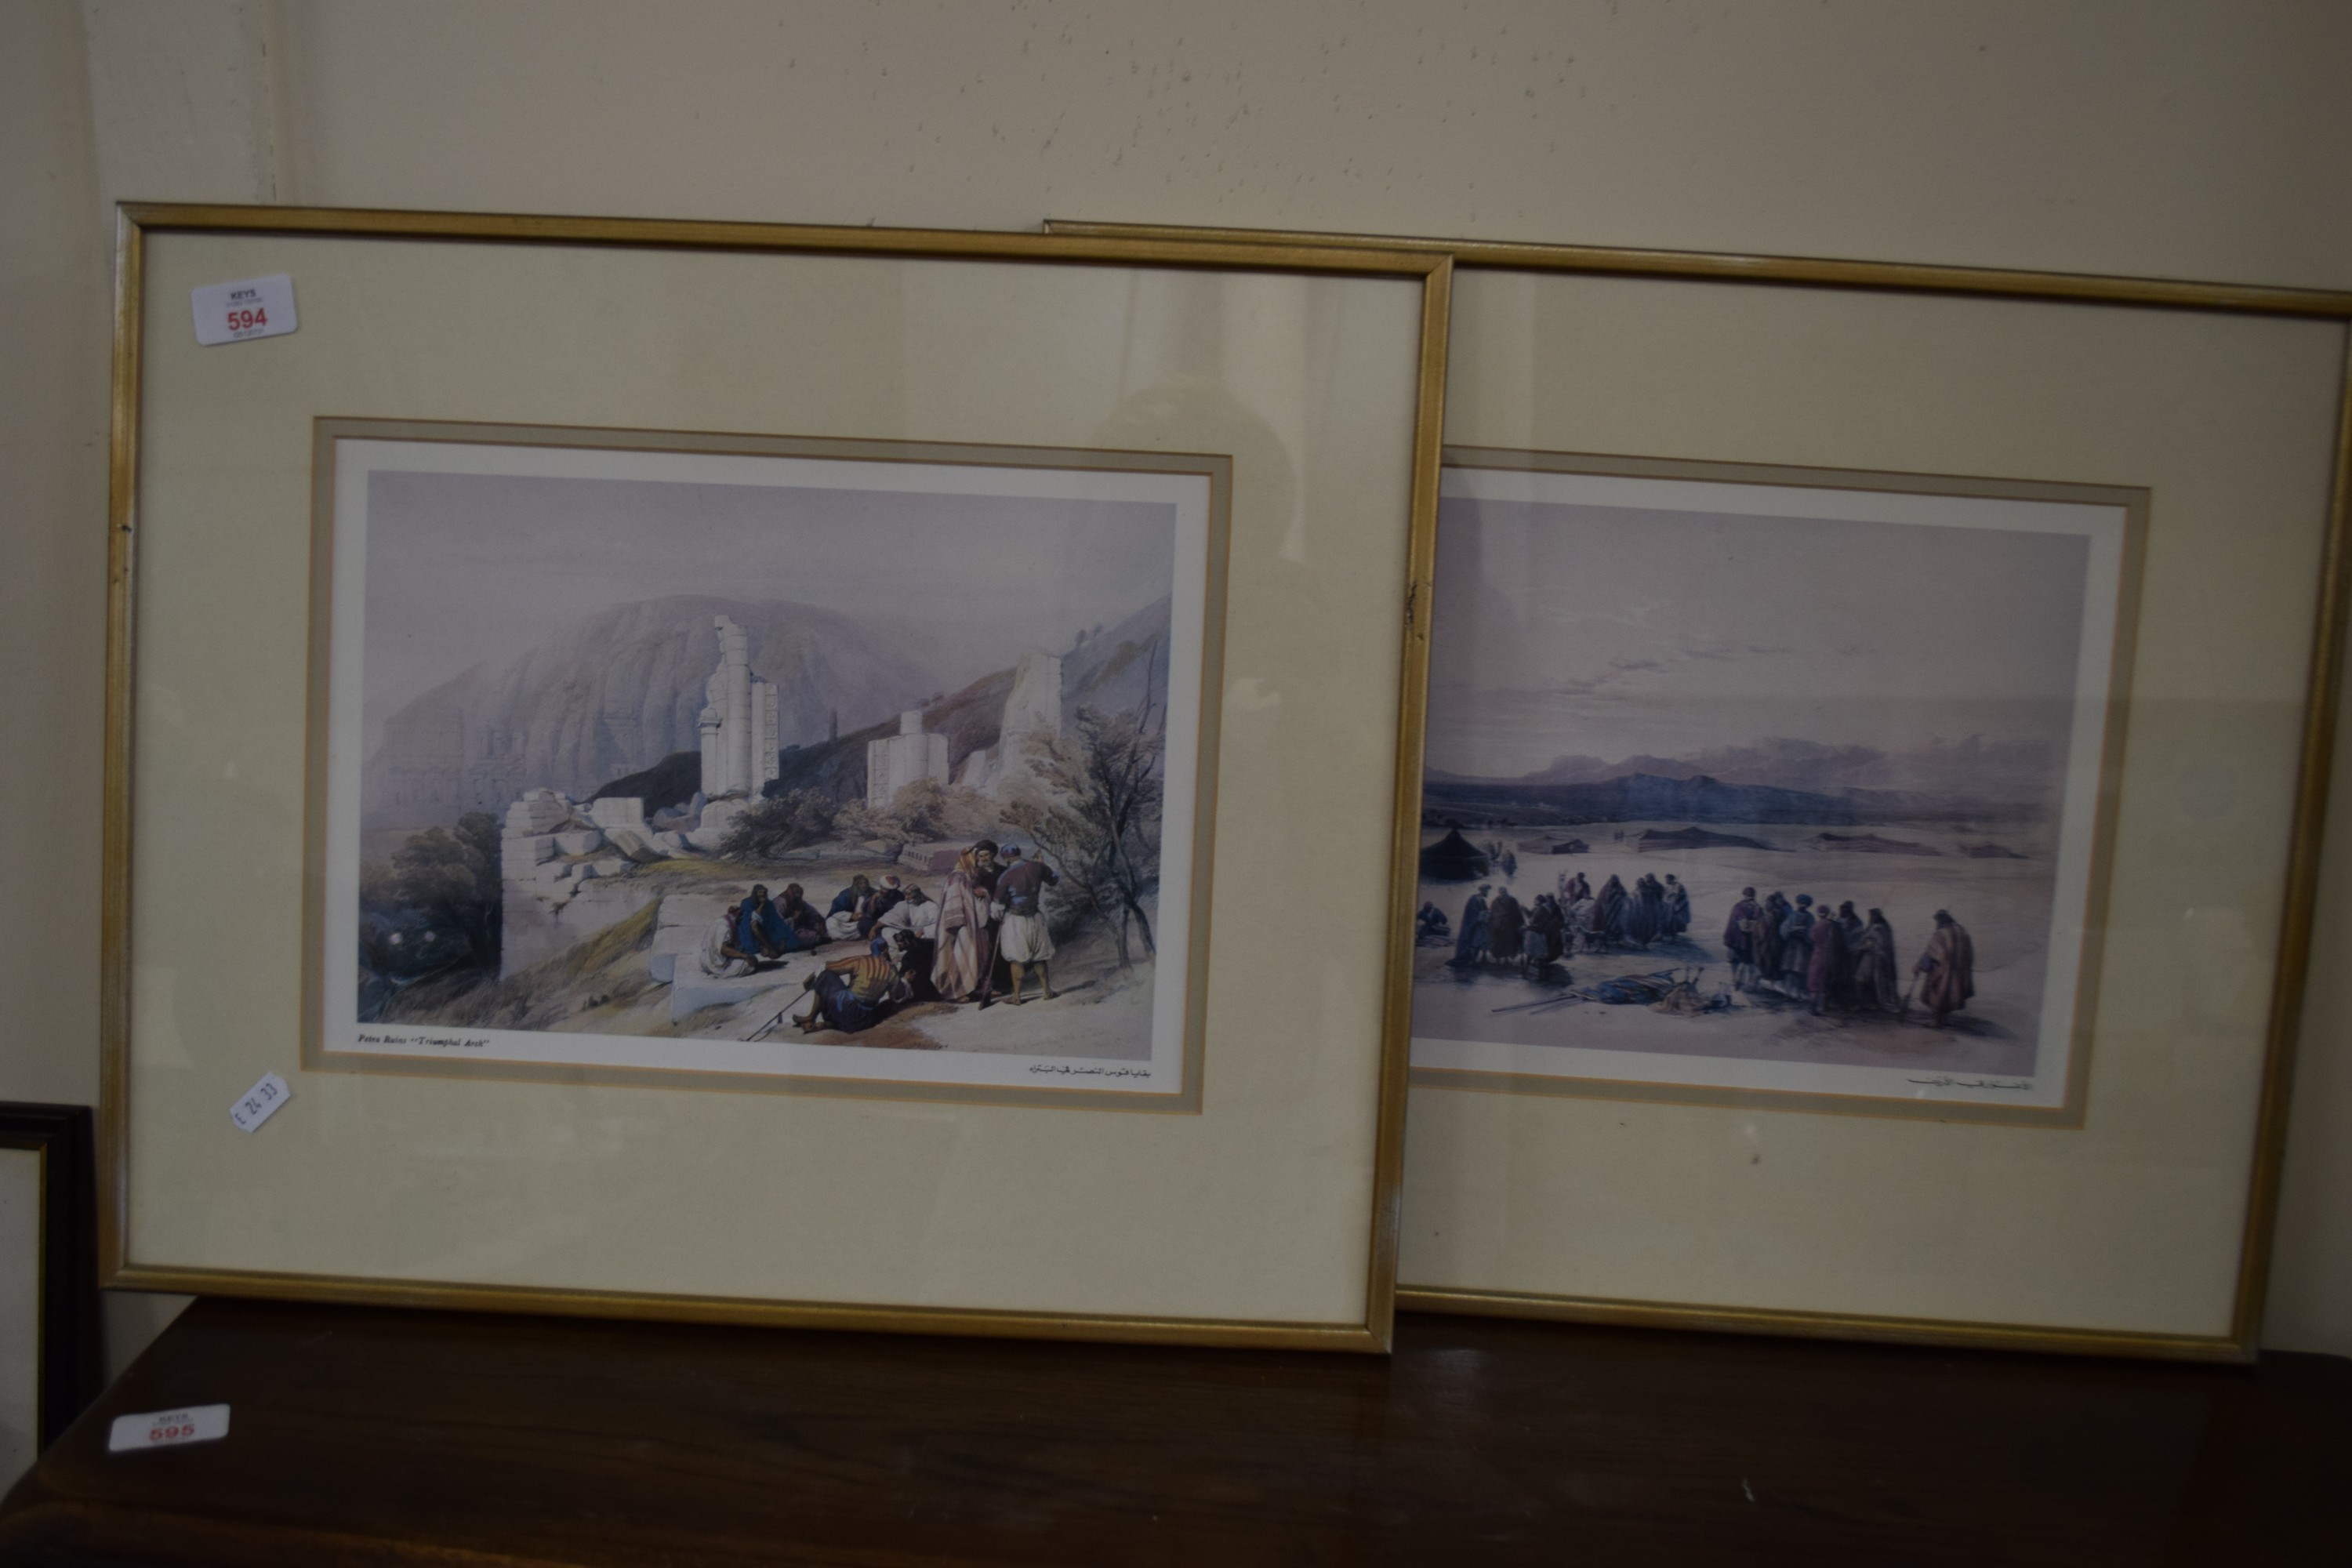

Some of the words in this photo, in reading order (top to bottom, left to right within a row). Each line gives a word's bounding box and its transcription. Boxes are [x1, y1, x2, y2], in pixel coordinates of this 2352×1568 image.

[230, 289, 256, 299] KEYS
[228, 307, 267, 331] 594
[358, 1034, 380, 1044] Petra
[383, 1034, 407, 1044] Ruins
